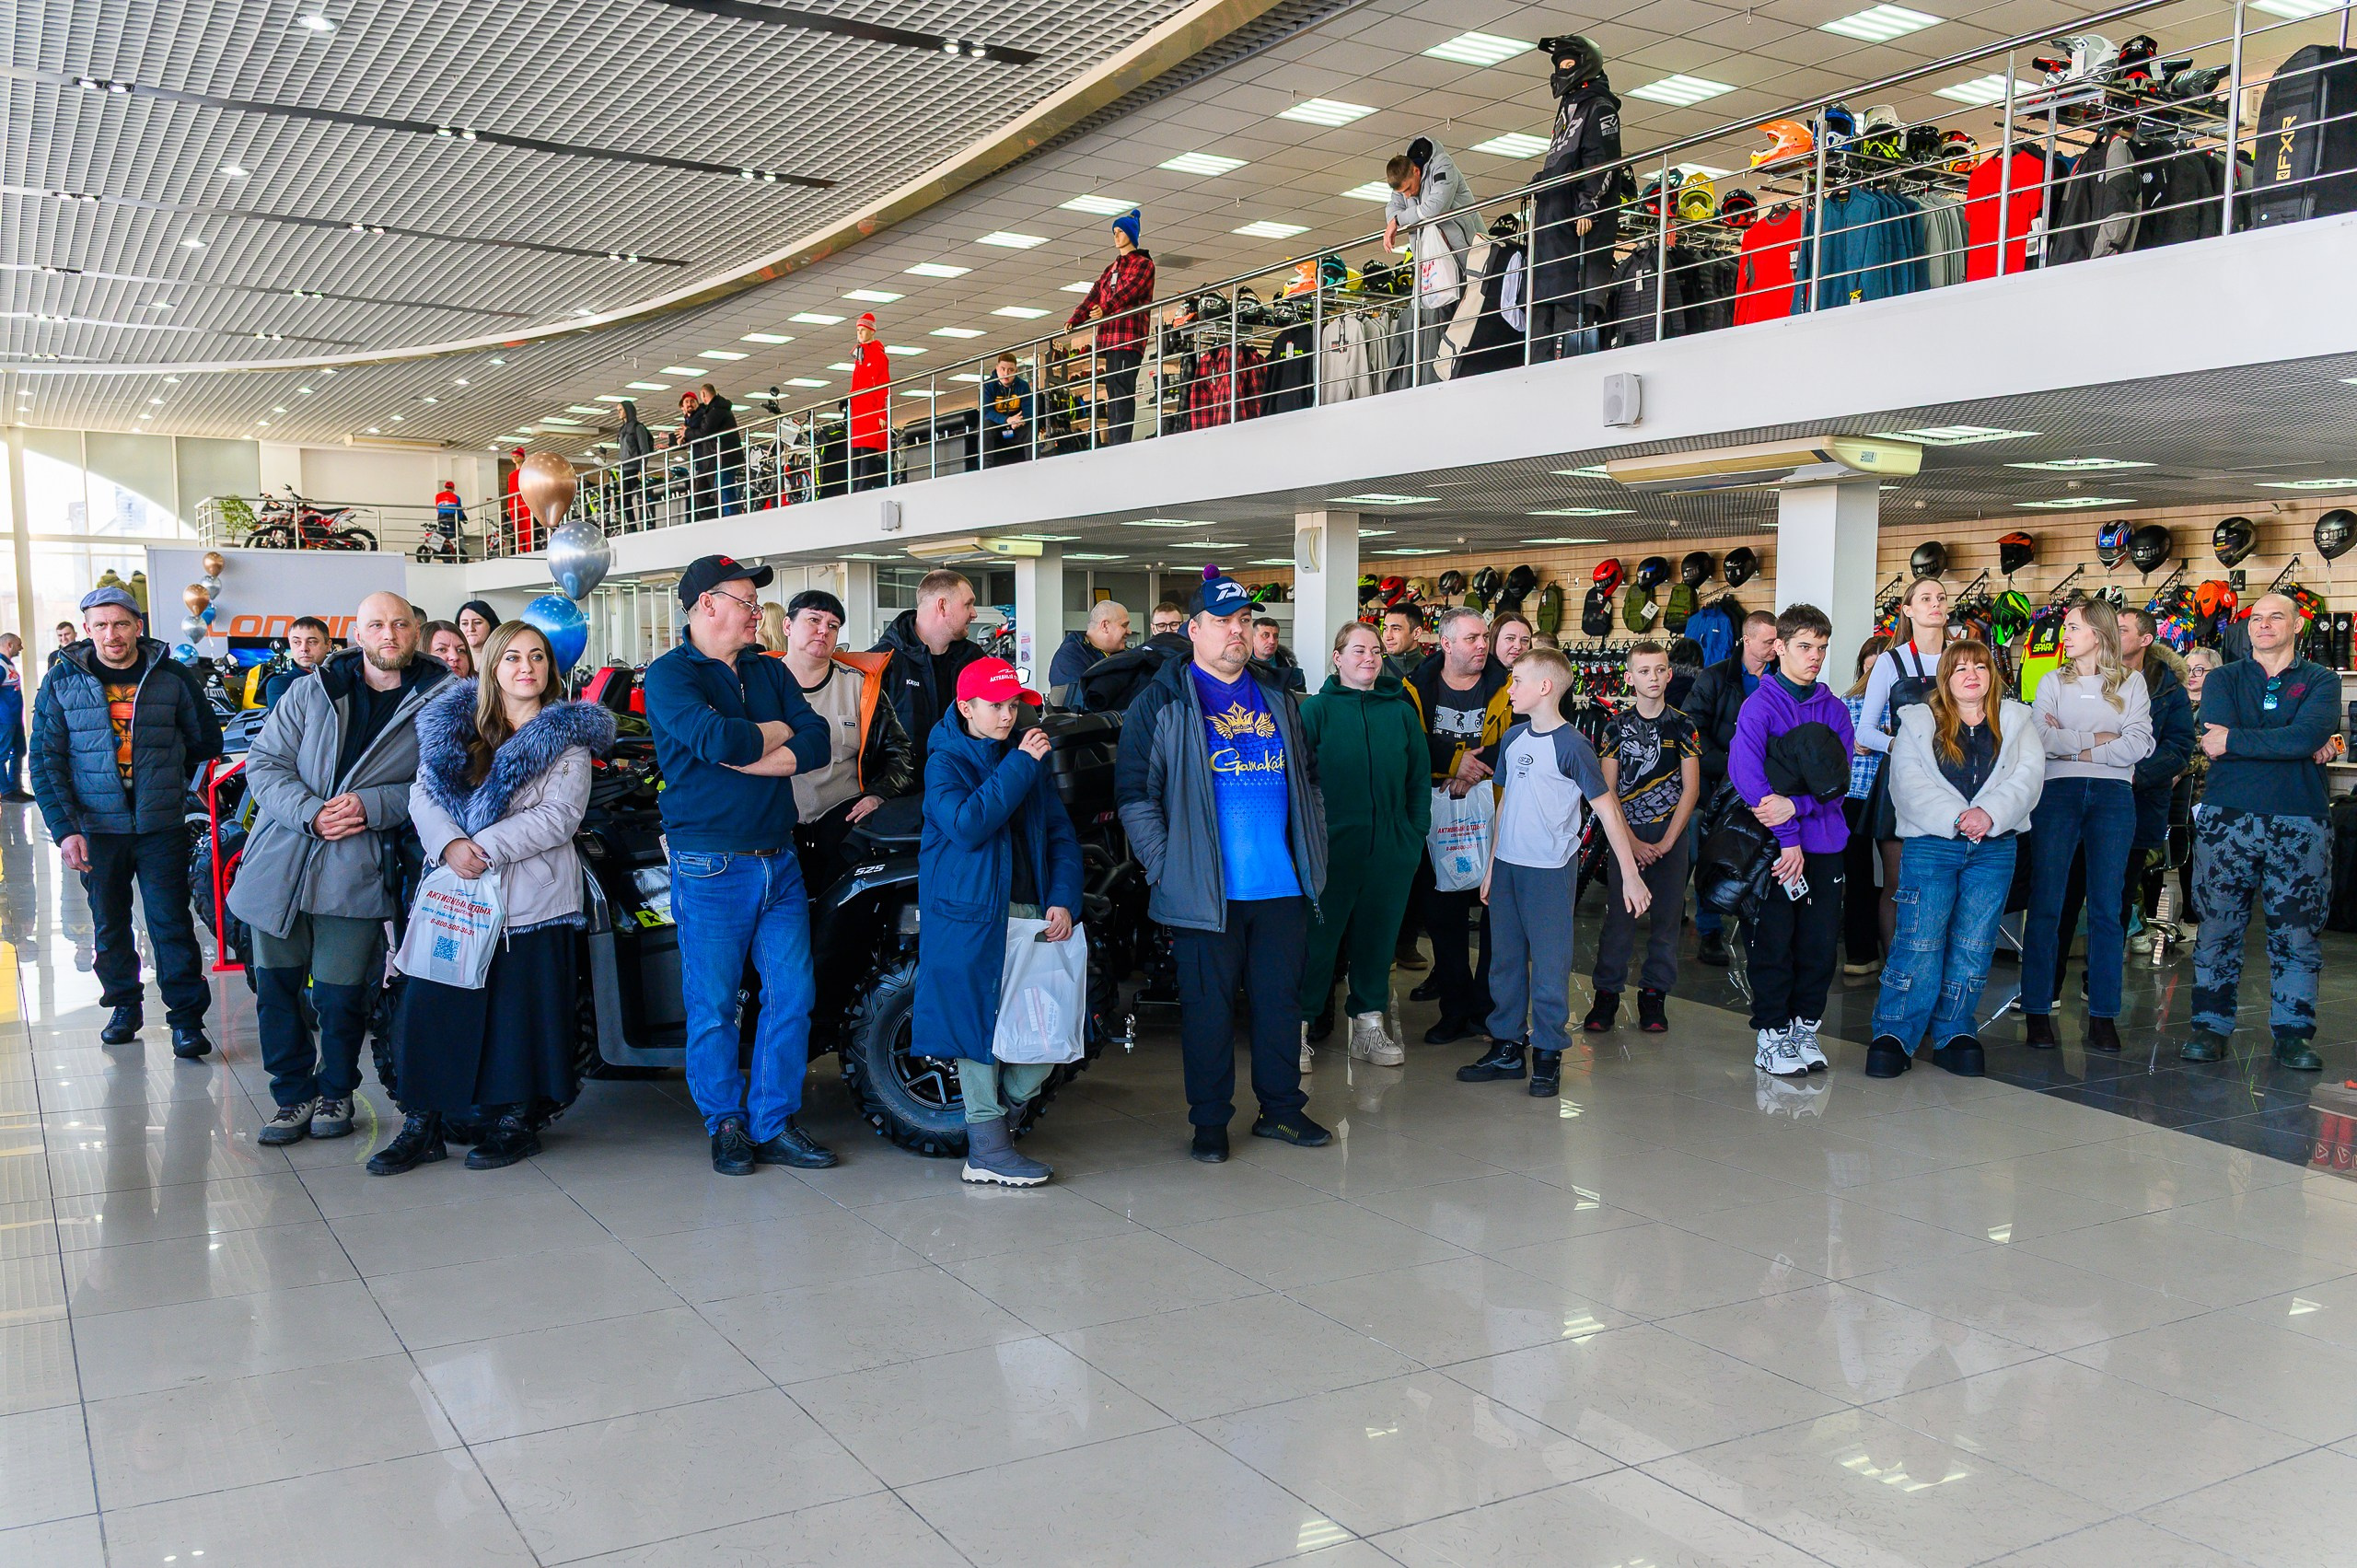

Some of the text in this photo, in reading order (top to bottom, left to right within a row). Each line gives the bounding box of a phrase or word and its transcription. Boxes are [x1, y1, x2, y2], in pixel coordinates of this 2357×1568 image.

[2033, 643, 2054, 653] SPARK
[906, 679, 920, 687] Kappa
[467, 903, 493, 916] ОТДЫХ
